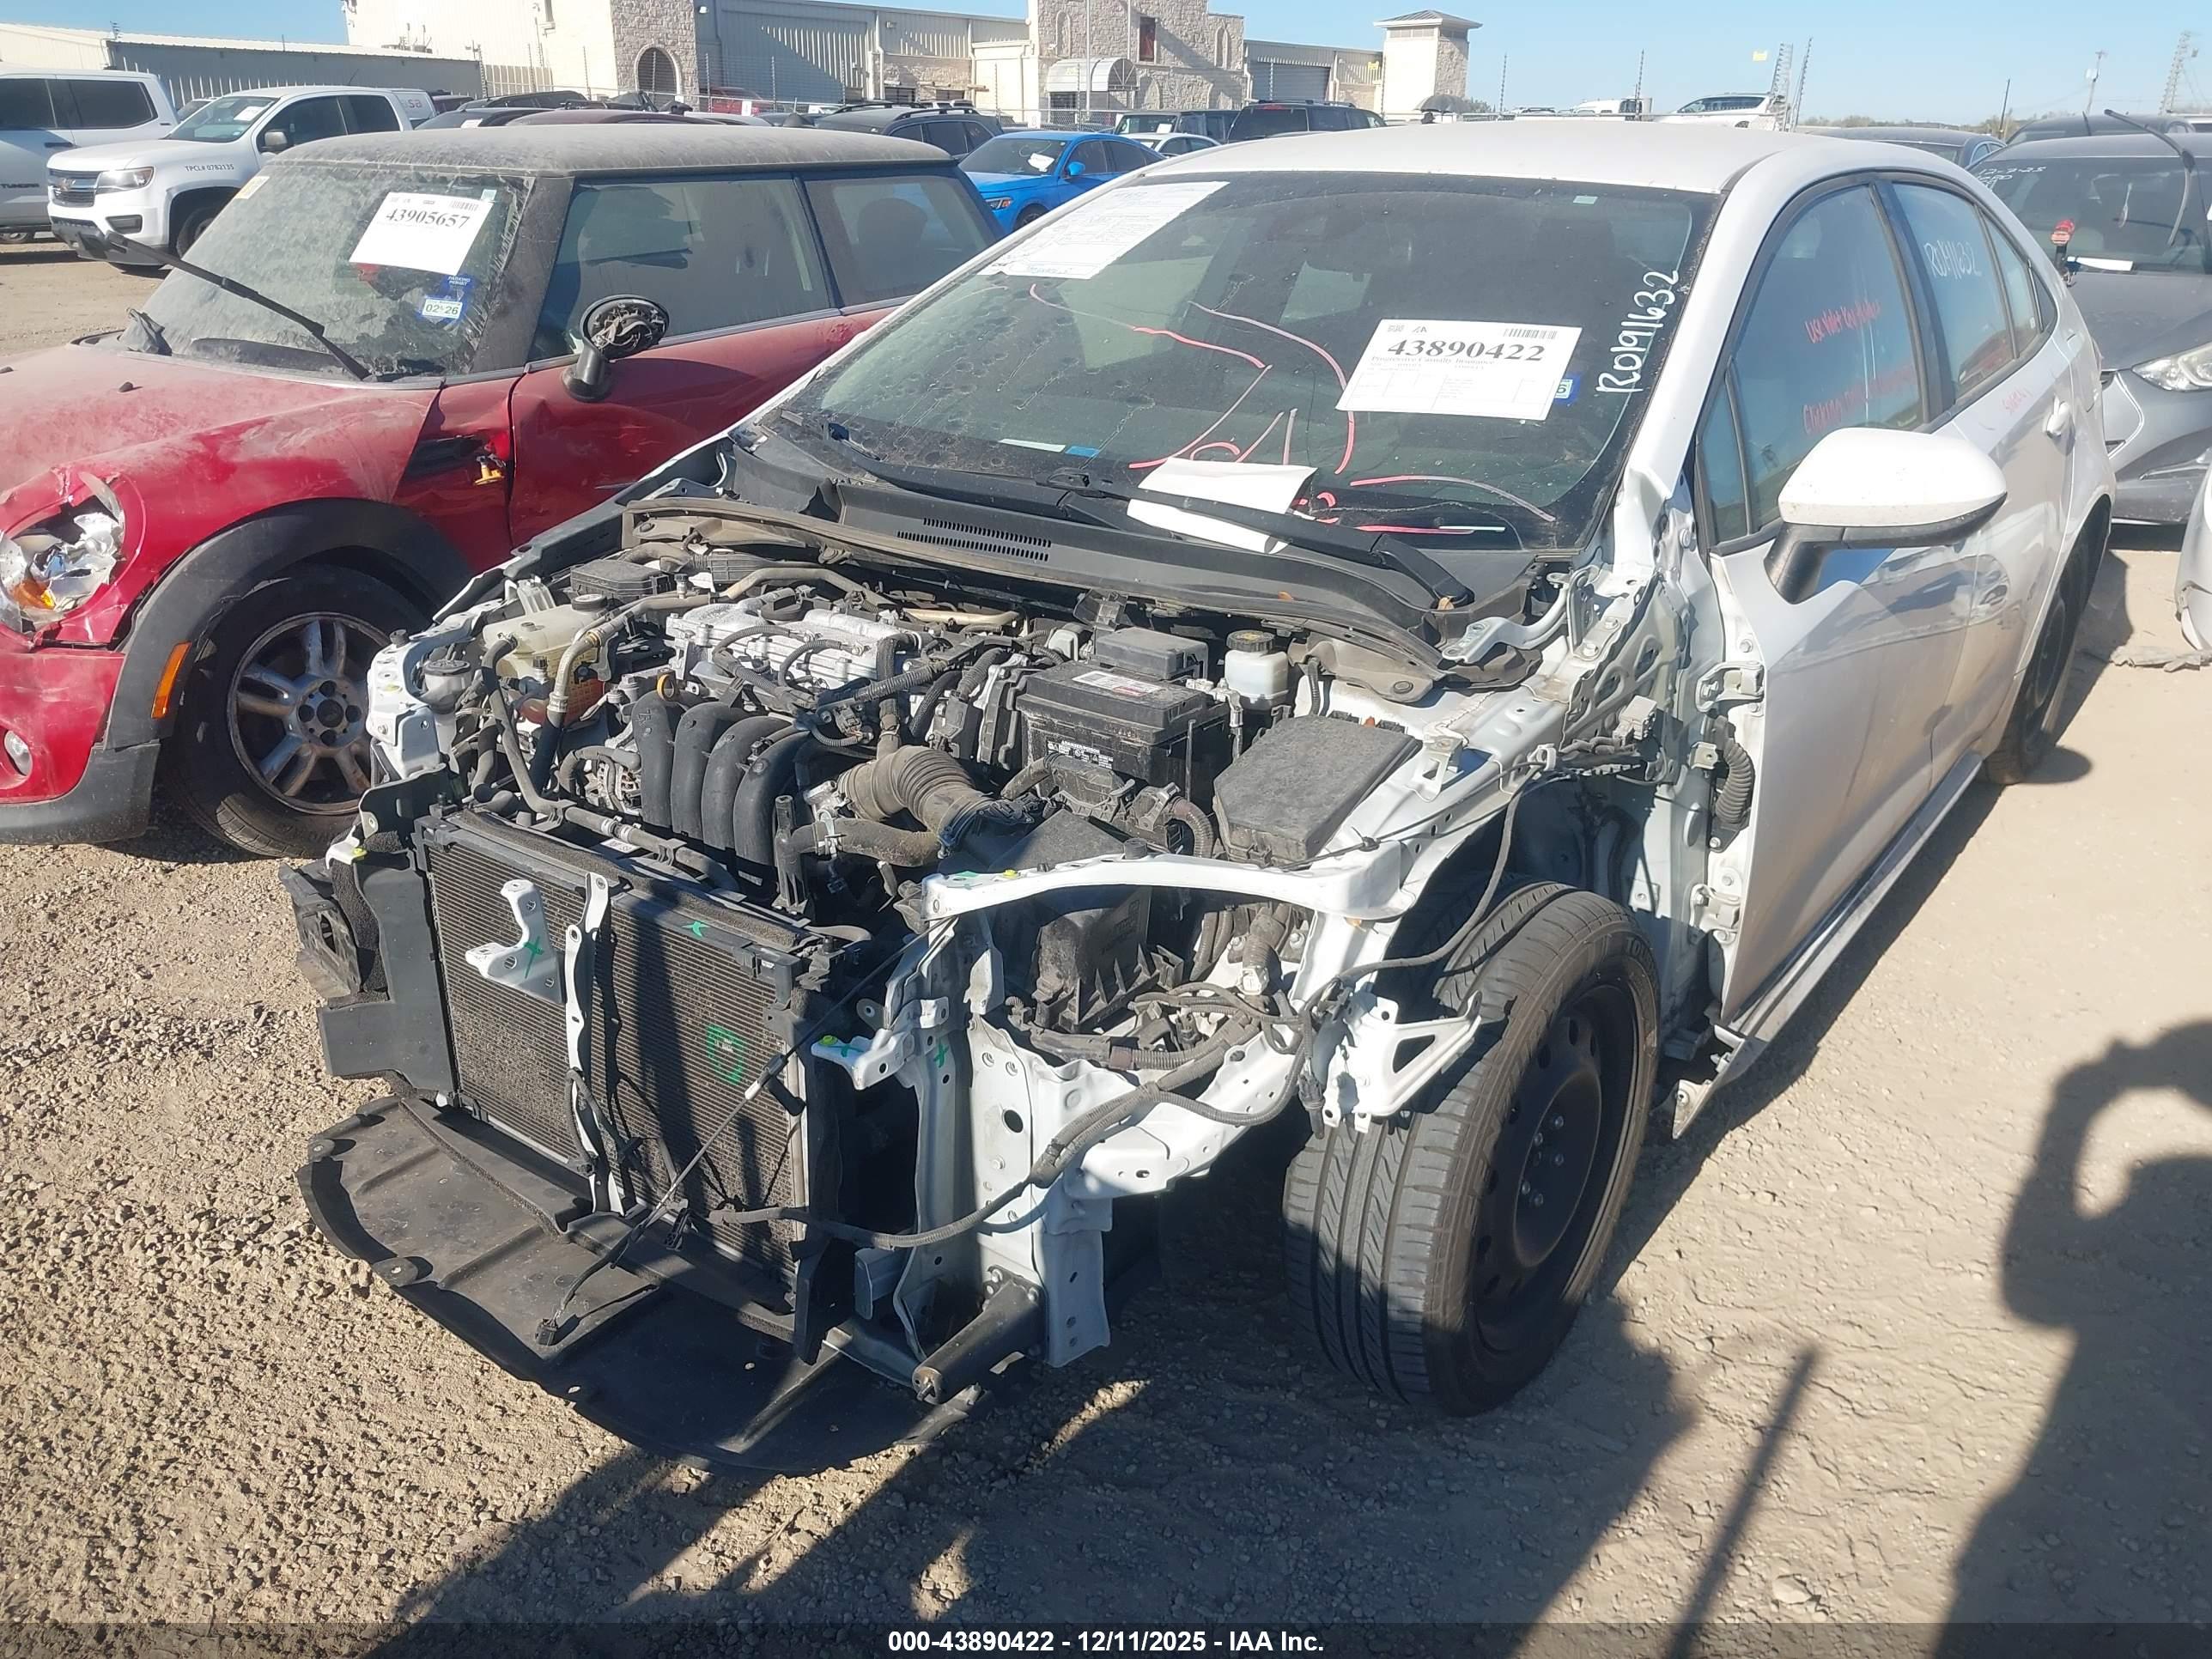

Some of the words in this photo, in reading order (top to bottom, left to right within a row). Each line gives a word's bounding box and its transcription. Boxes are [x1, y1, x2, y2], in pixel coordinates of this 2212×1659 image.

[386, 208, 471, 229] 43905657
[425, 303, 440, 313] 02
[444, 306, 459, 315] 26
[1388, 339, 1545, 362] 43890422
